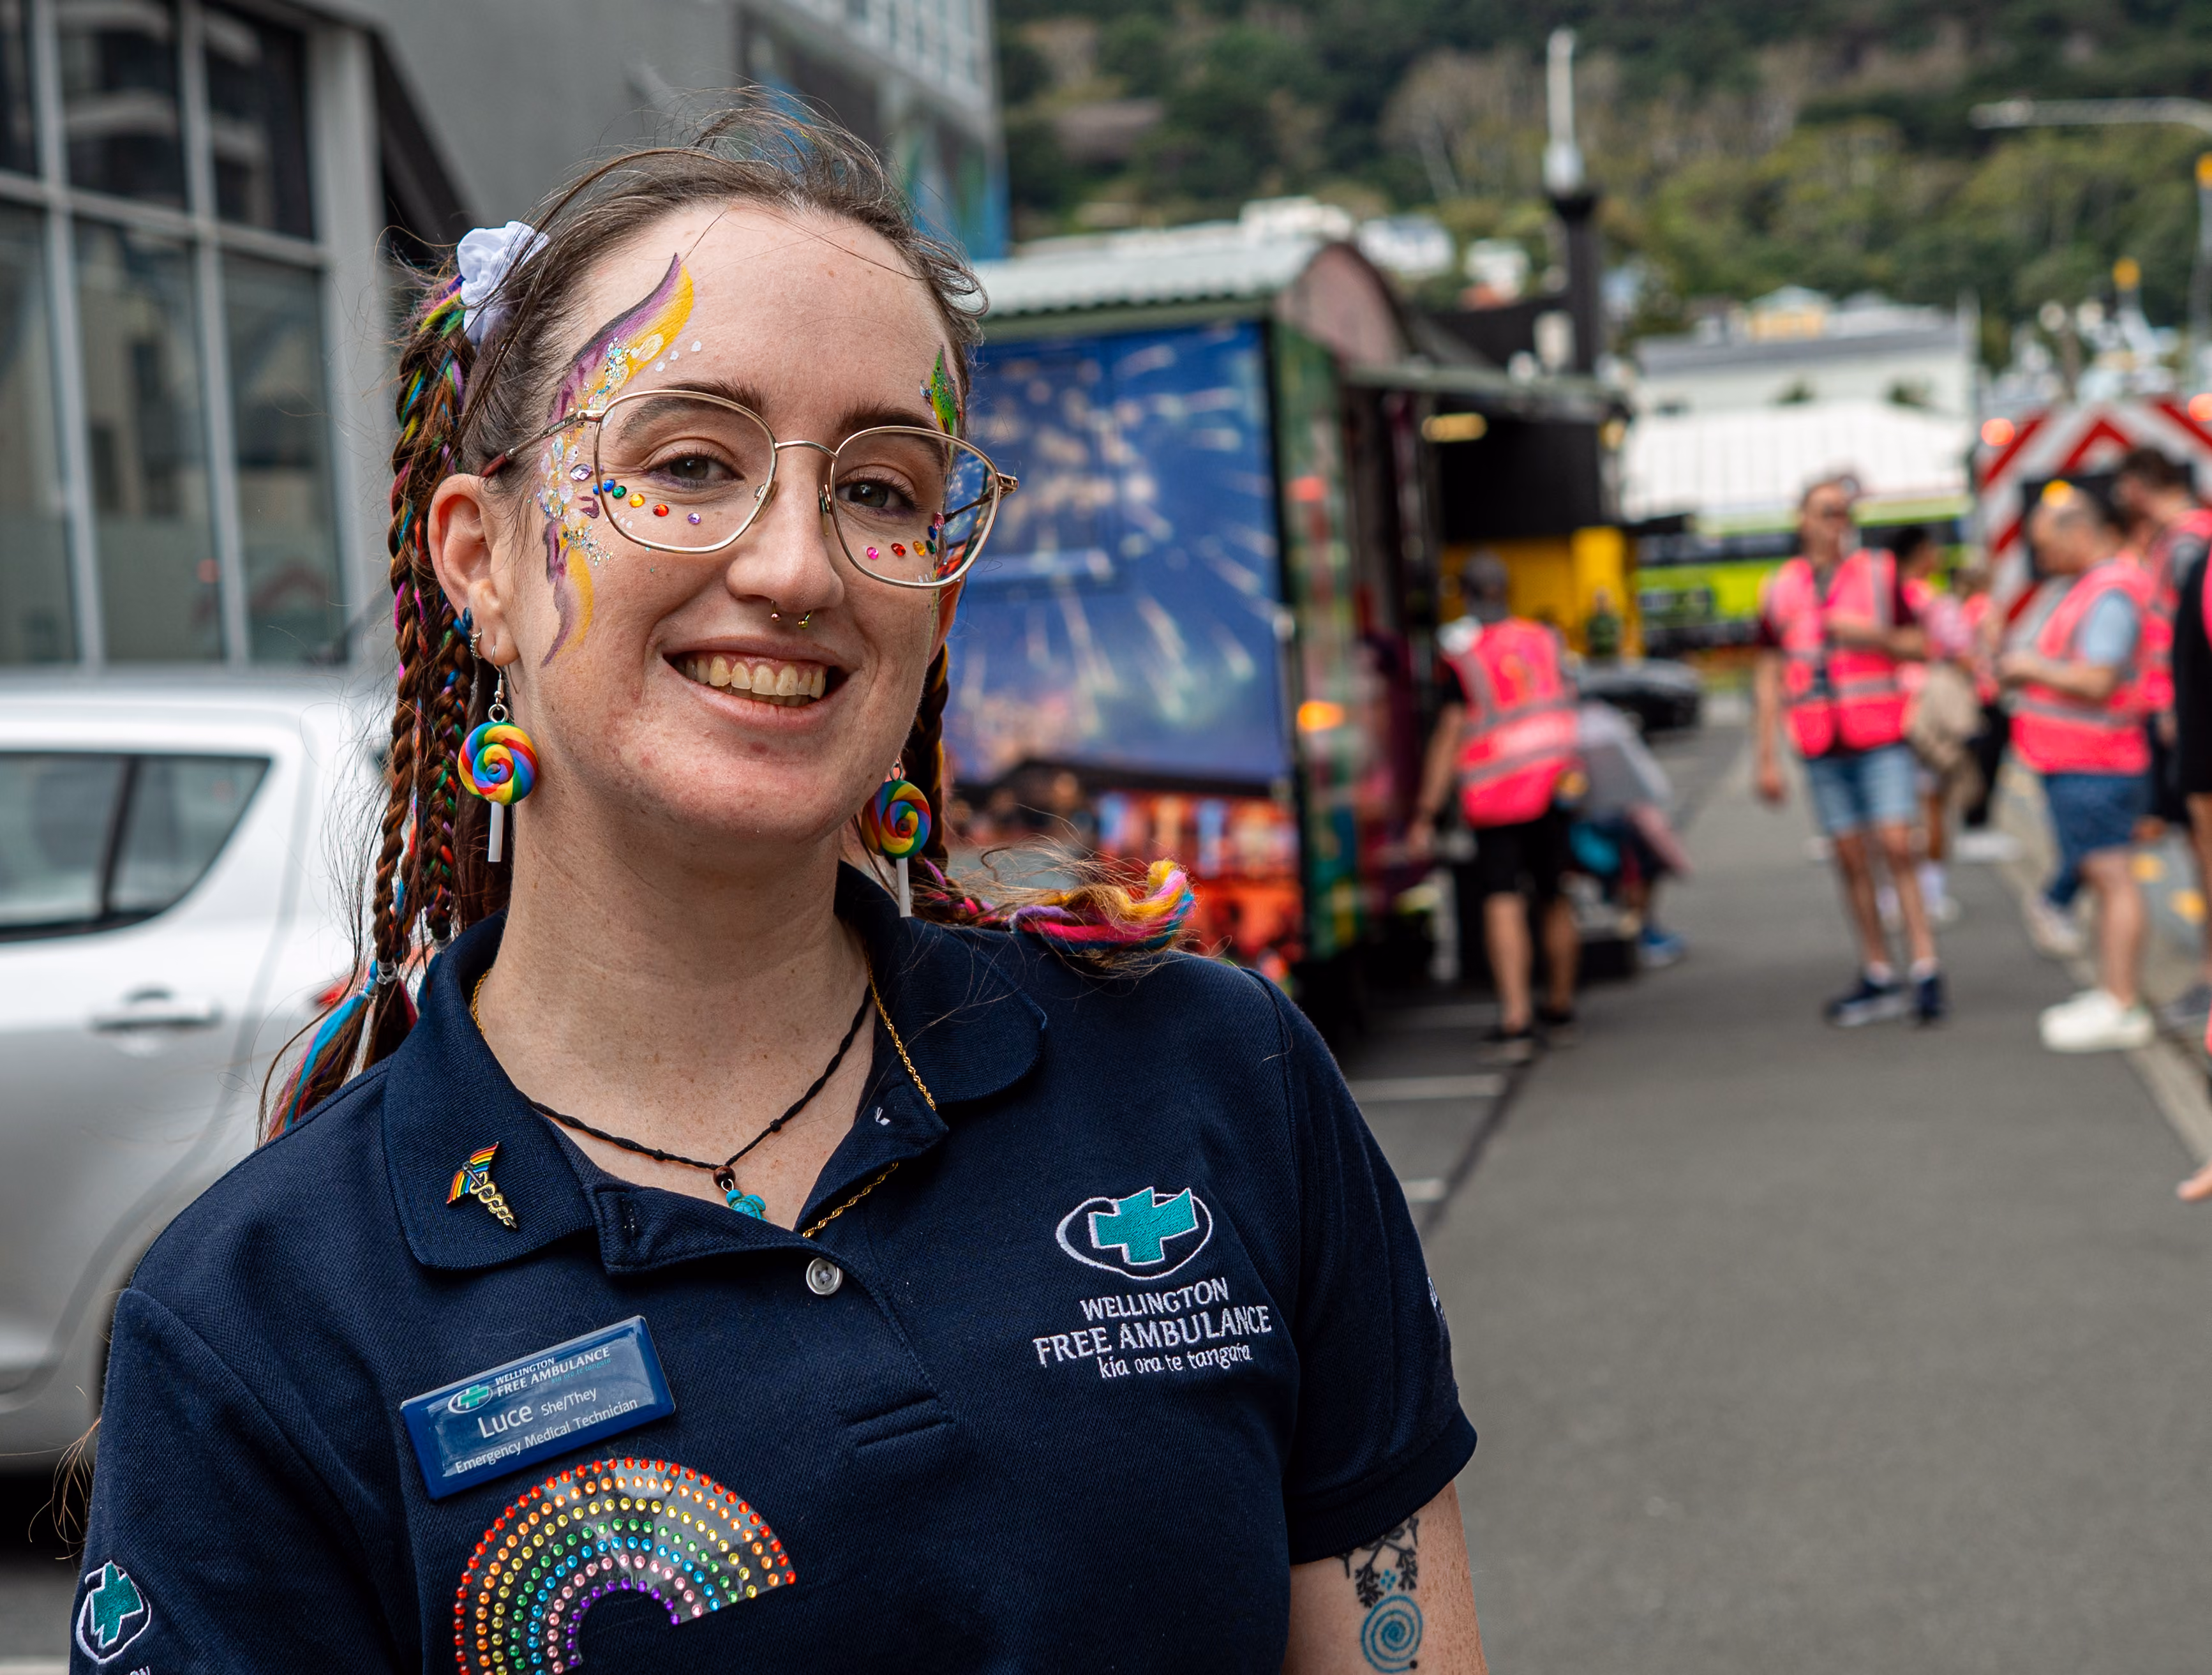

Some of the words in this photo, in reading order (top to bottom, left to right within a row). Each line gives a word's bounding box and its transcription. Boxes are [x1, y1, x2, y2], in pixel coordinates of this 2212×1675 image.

[1079, 1277, 1229, 1321] WELLINGTON
[1032, 1327, 1112, 1368] FREE
[1119, 1305, 1272, 1349] AMBULANCE
[1096, 1355, 1131, 1379] kia
[1133, 1356, 1165, 1374] ora
[1165, 1354, 1184, 1371] te
[1186, 1342, 1253, 1369] tangata
[495, 1357, 556, 1385] WELLINGTON
[497, 1377, 528, 1397] FREE
[530, 1346, 610, 1385] AMBULANCE
[455, 1441, 521, 1474] Emergency
[524, 1420, 571, 1448] Medical
[572, 1399, 638, 1430] Technician
[477, 1405, 534, 1439] Luce
[541, 1388, 597, 1416] She/They
